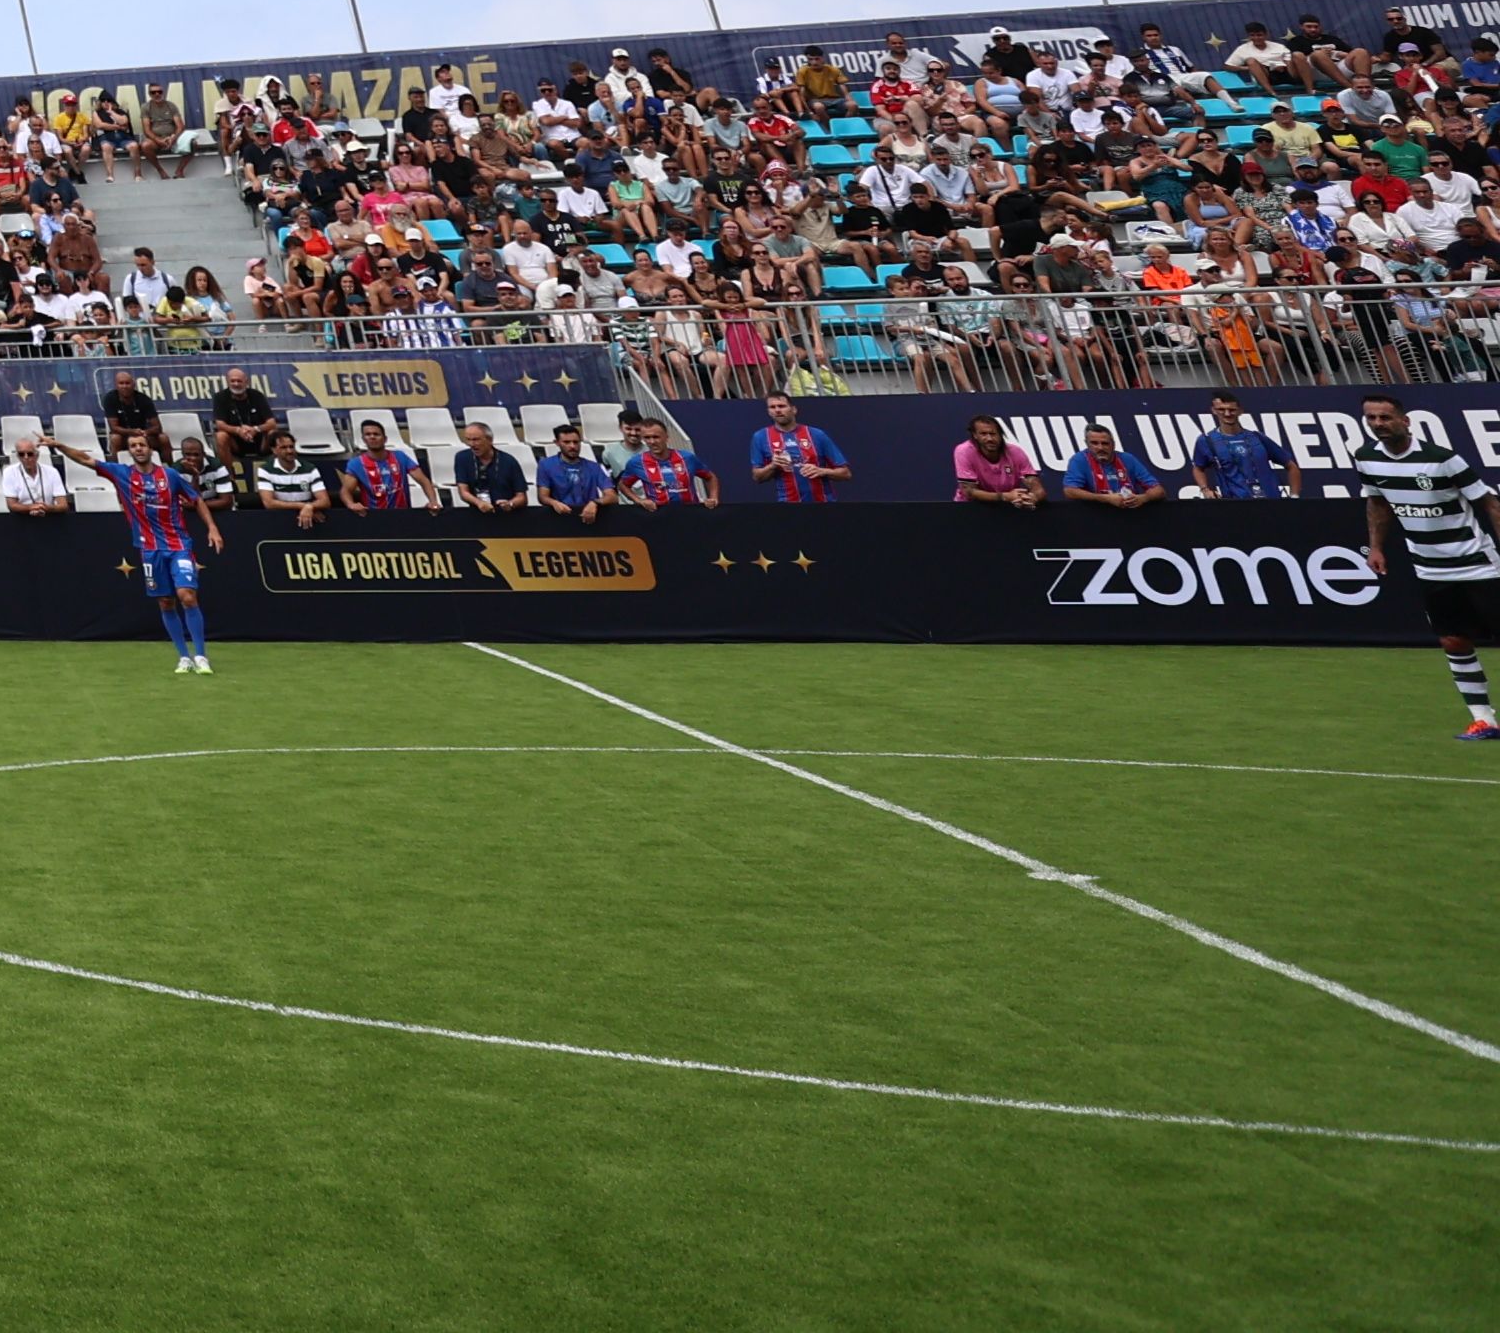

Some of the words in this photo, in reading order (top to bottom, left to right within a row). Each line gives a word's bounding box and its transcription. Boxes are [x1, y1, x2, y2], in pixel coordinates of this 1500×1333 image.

[172, 373, 278, 400] PORTAL
[323, 372, 430, 397] LEGENDS
[1133, 411, 1452, 472] UNVERO
[284, 552, 336, 580] LIGA
[342, 551, 462, 580] PORTUGAL
[513, 550, 634, 578] LEGENDS
[1033, 545, 1380, 606] zome
